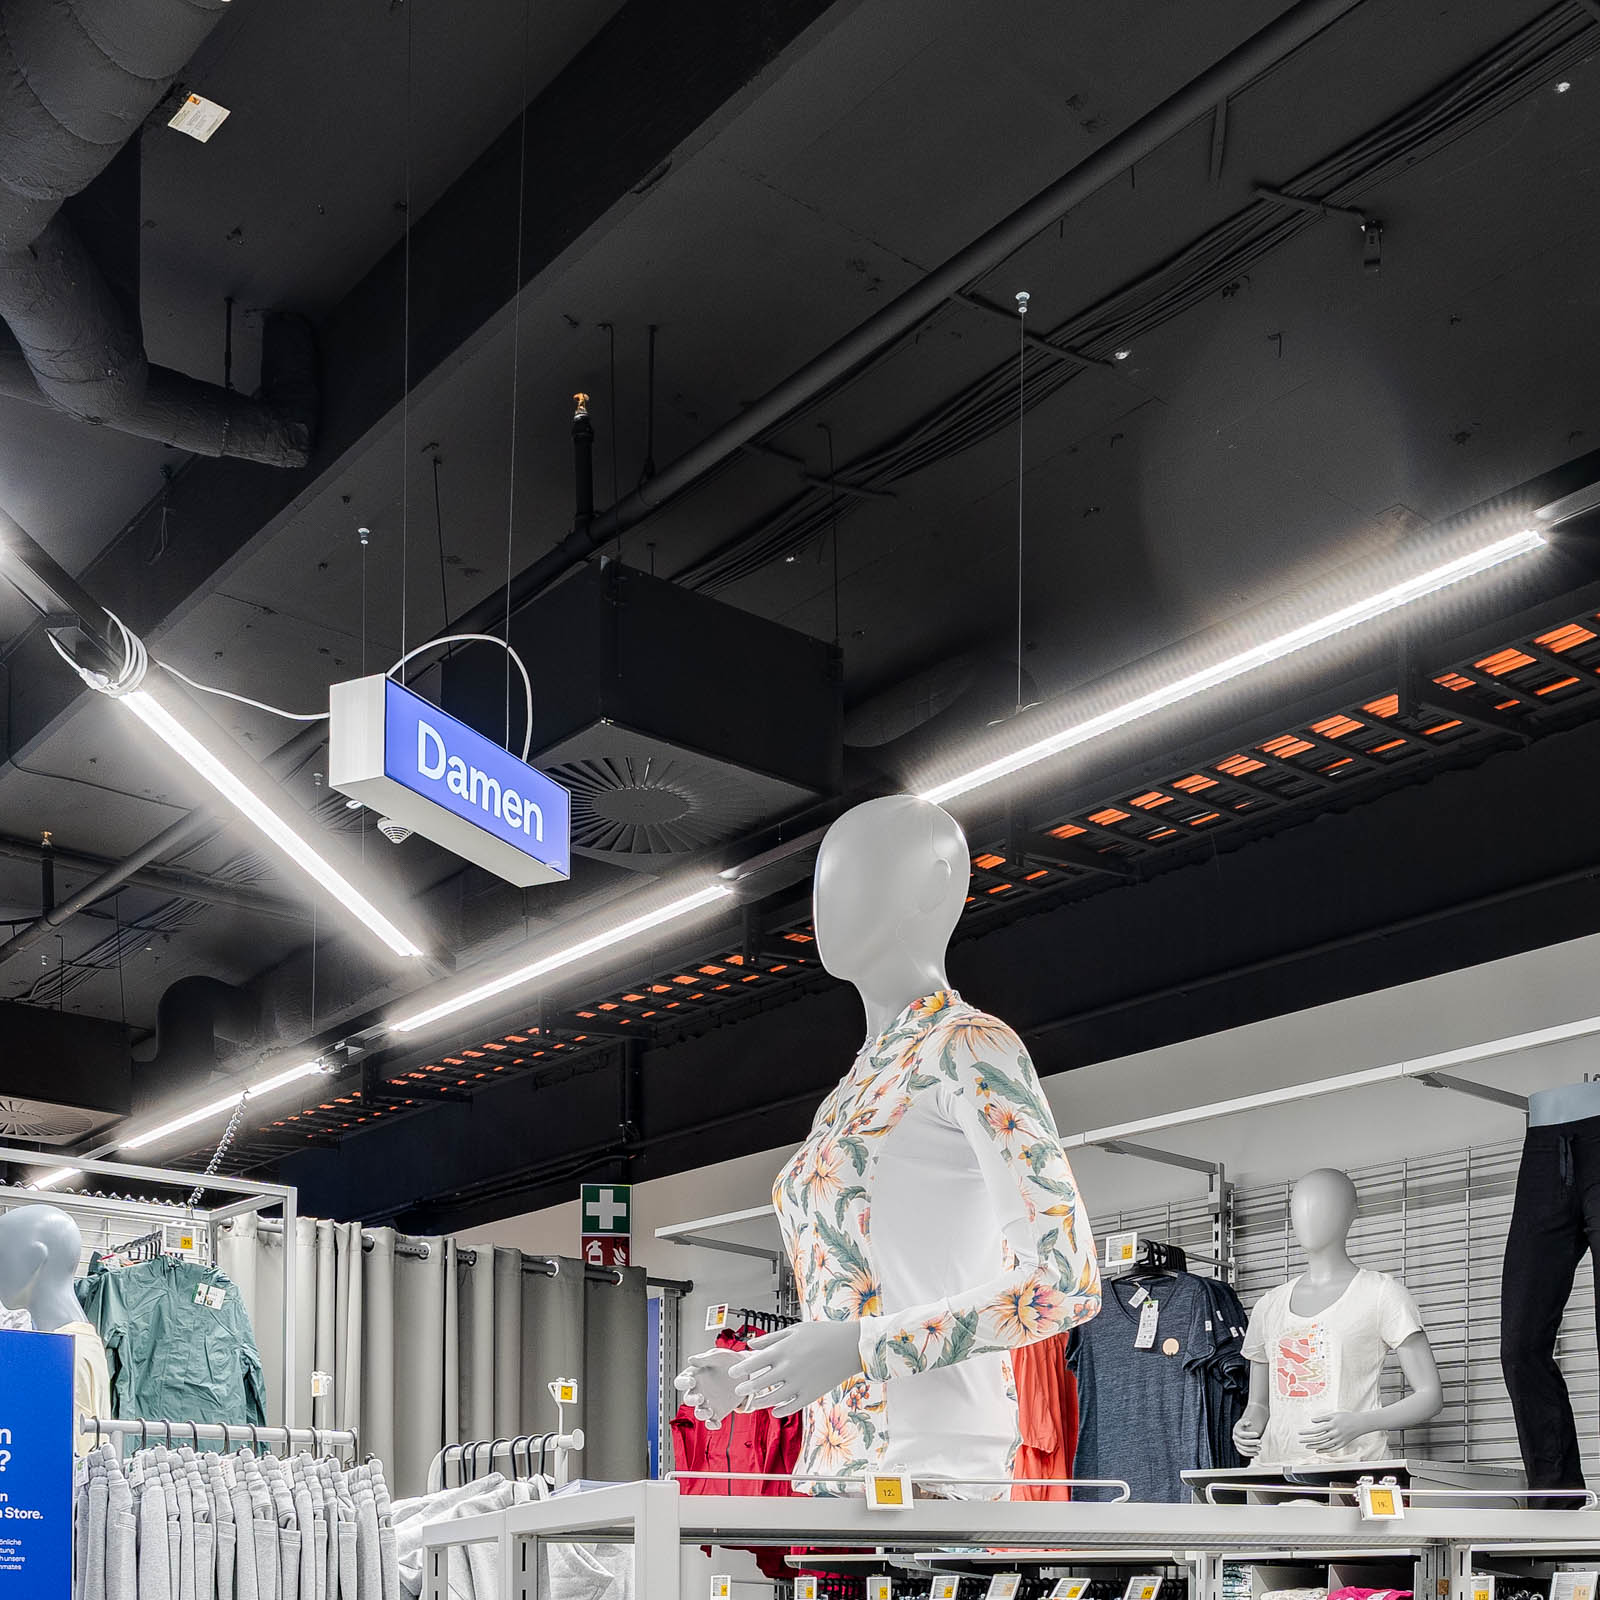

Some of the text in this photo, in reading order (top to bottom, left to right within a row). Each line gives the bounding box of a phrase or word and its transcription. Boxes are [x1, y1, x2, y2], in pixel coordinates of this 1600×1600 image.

[417, 719, 543, 842] Damen
[4, 1507, 44, 1520] Store.
[3, 1555, 25, 1563] unsere
